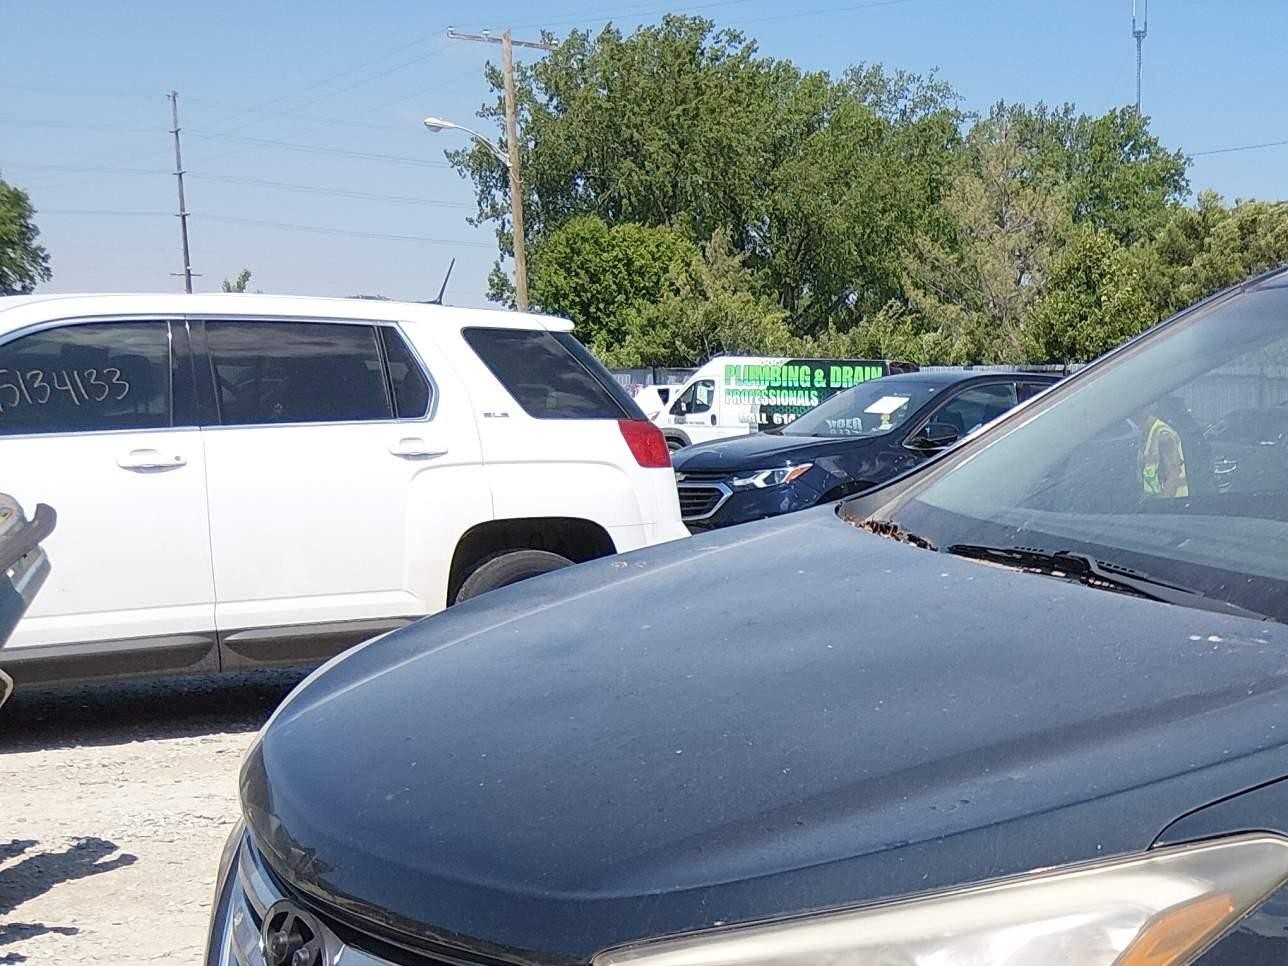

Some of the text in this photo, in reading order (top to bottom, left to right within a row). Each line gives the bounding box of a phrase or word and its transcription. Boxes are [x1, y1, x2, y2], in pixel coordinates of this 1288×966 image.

[725, 364, 882, 388] PLUMBING & DRAIN
[0, 367, 130, 412] 5134133
[725, 388, 819, 407] PROFESSIONALS
